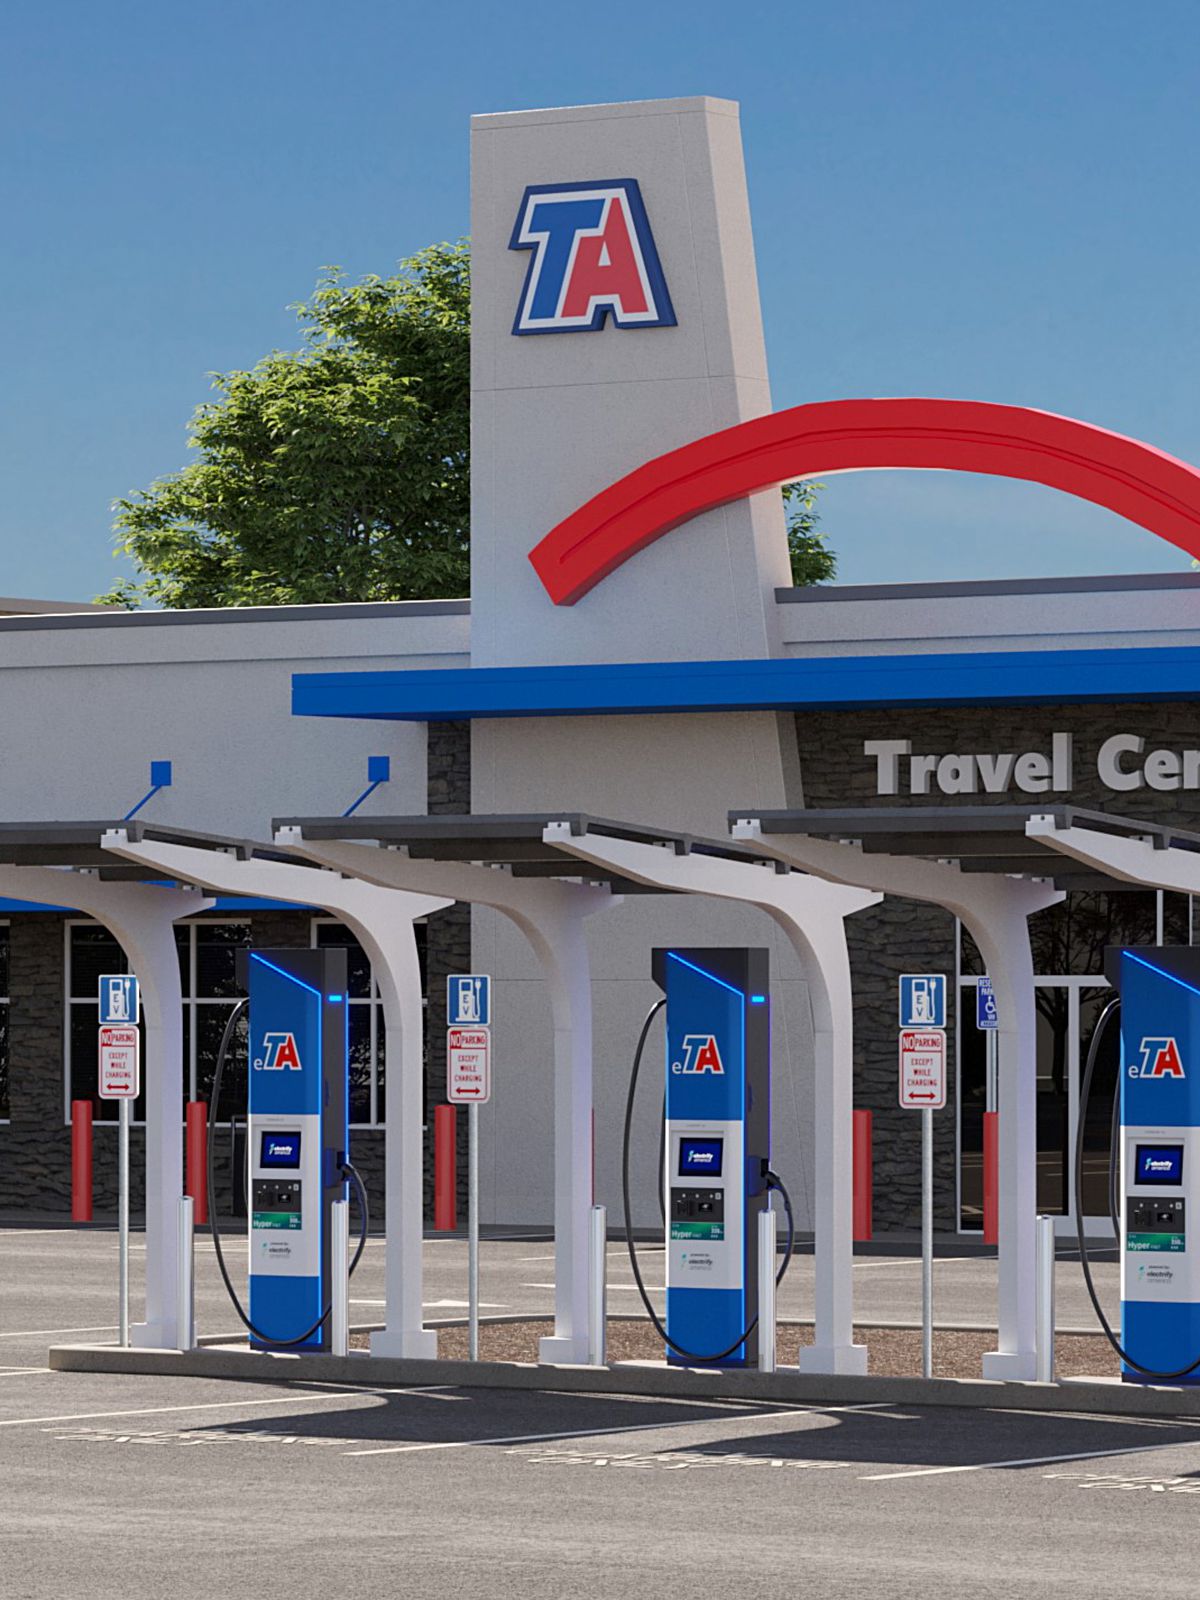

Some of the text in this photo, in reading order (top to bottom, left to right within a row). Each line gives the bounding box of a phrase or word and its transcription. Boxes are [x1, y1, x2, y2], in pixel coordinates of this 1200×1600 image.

[510, 178, 677, 336] TA
[864, 732, 1073, 795] Travel
[461, 1035, 486, 1045] PARKING
[903, 1037, 940, 1049] NO PARKING
[907, 1079, 938, 1087] CHARGING
[1128, 1241, 1150, 1251] Hyper
